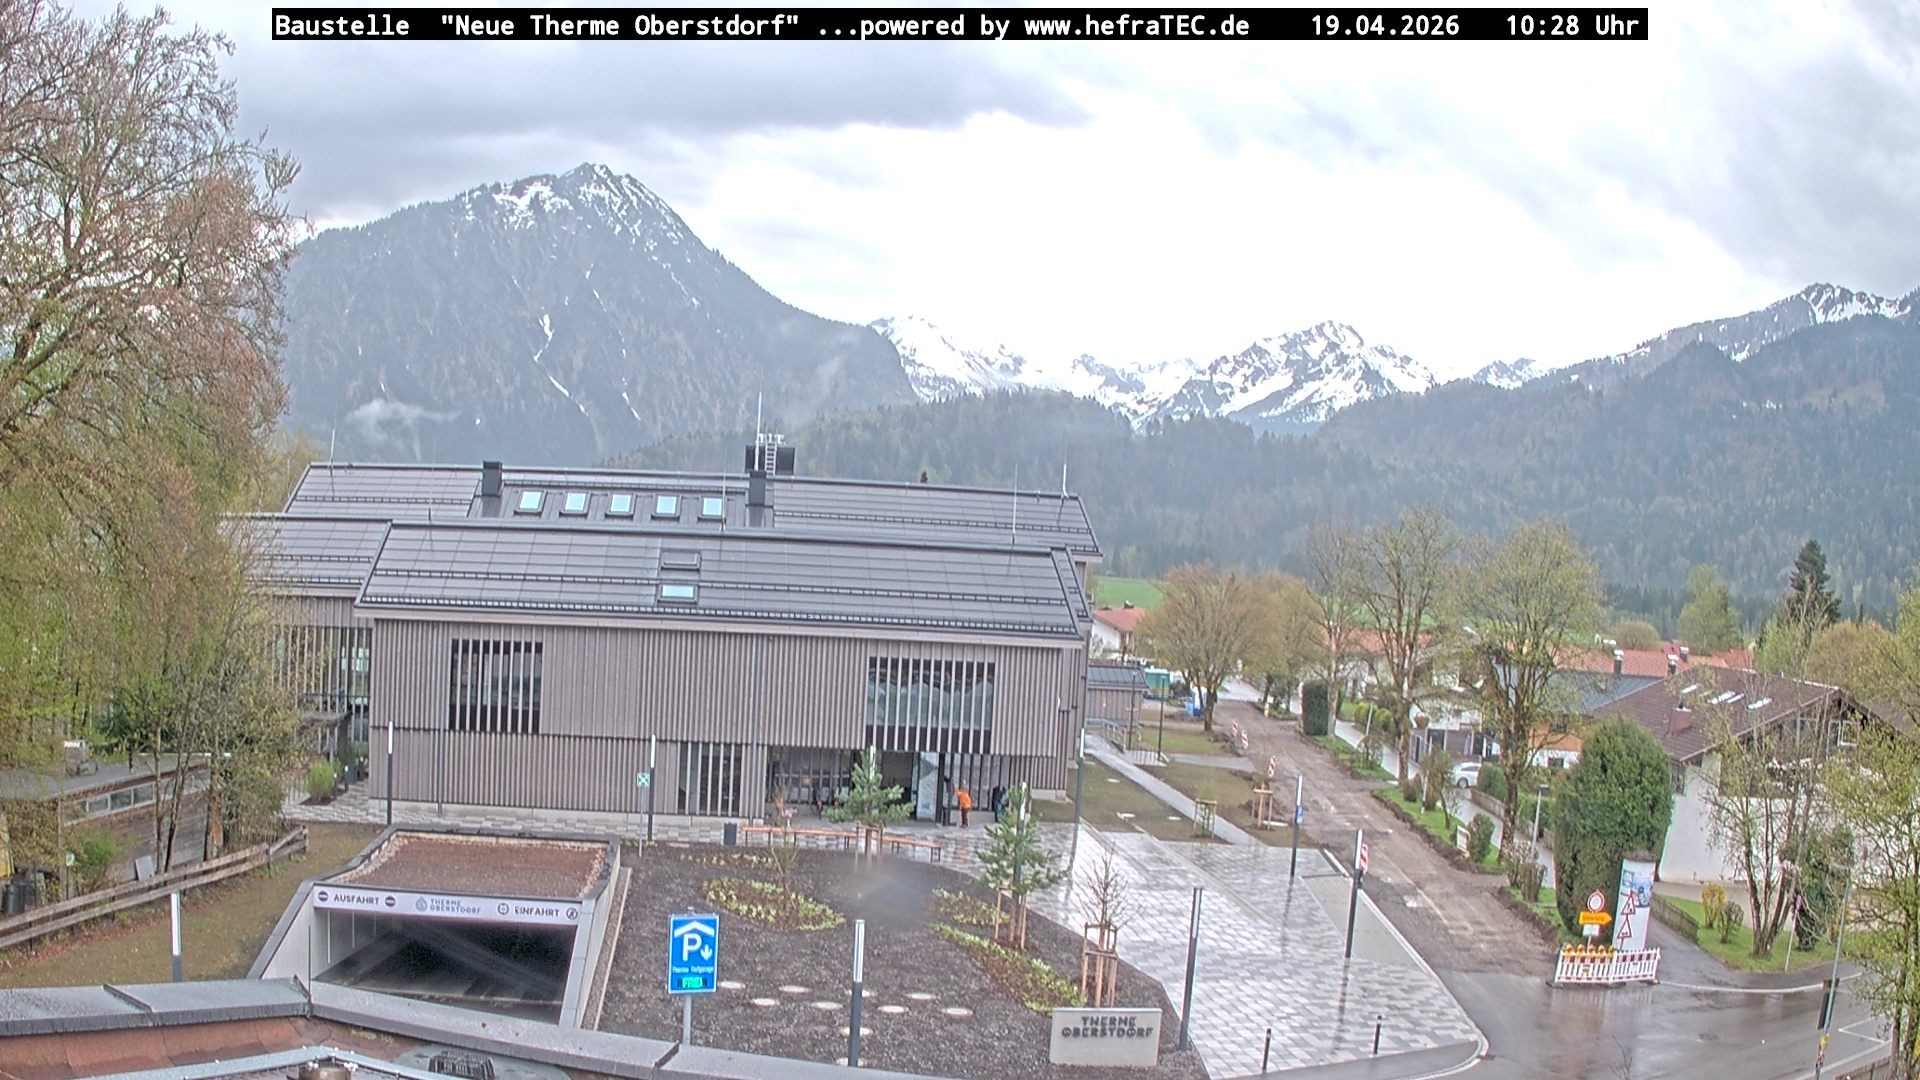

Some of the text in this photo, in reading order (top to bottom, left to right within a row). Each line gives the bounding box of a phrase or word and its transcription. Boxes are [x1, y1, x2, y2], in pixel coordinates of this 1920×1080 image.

[333, 894, 380, 905] AUSFAHRT
[429, 898, 462, 907] THERME
[429, 904, 481, 915] OBERSTDORF
[514, 906, 560, 917] EINFAHRT
[682, 933, 702, 962] P
[1081, 1016, 1137, 1026] THERME
[1061, 1027, 1154, 1038] OBERSTDORF
